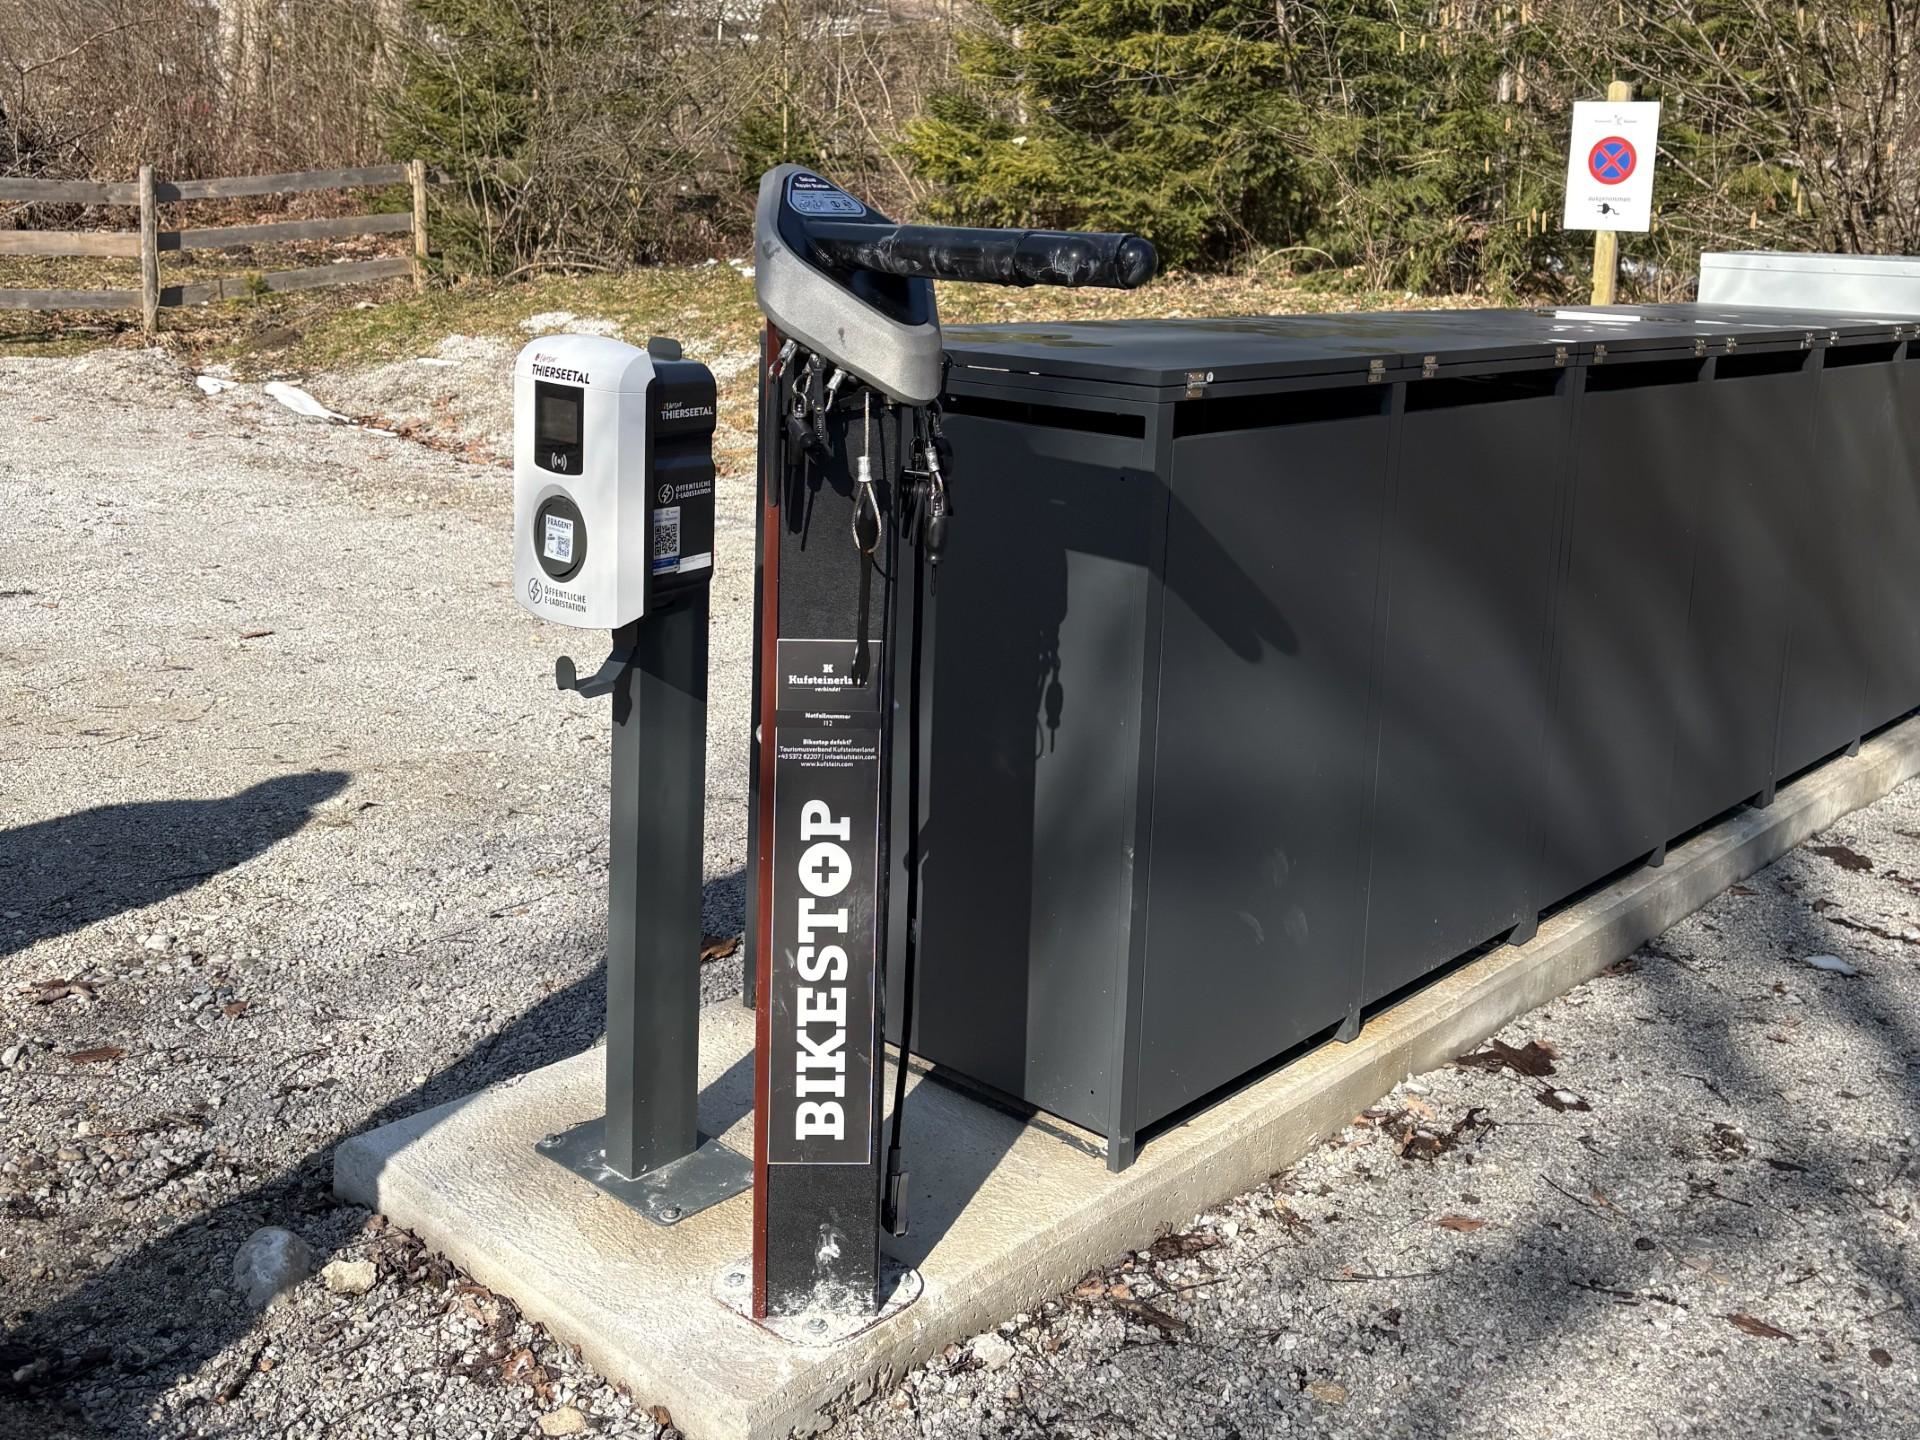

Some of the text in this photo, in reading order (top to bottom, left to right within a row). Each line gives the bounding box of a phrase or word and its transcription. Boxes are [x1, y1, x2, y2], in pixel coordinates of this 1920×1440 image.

[532, 363, 590, 385] THIERSEETAL
[661, 406, 713, 420] THIERSEETAL
[675, 487, 711, 500] E-LADESTATION
[547, 516, 572, 530] FRAGEN?
[544, 585, 587, 604] ÖFFENTLICHE
[544, 596, 587, 613] E-LADESTATION
[788, 675, 867, 685] Kufsteinerla
[803, 738, 828, 746] Bikestop
[795, 799, 852, 1141] BIKESTOP
